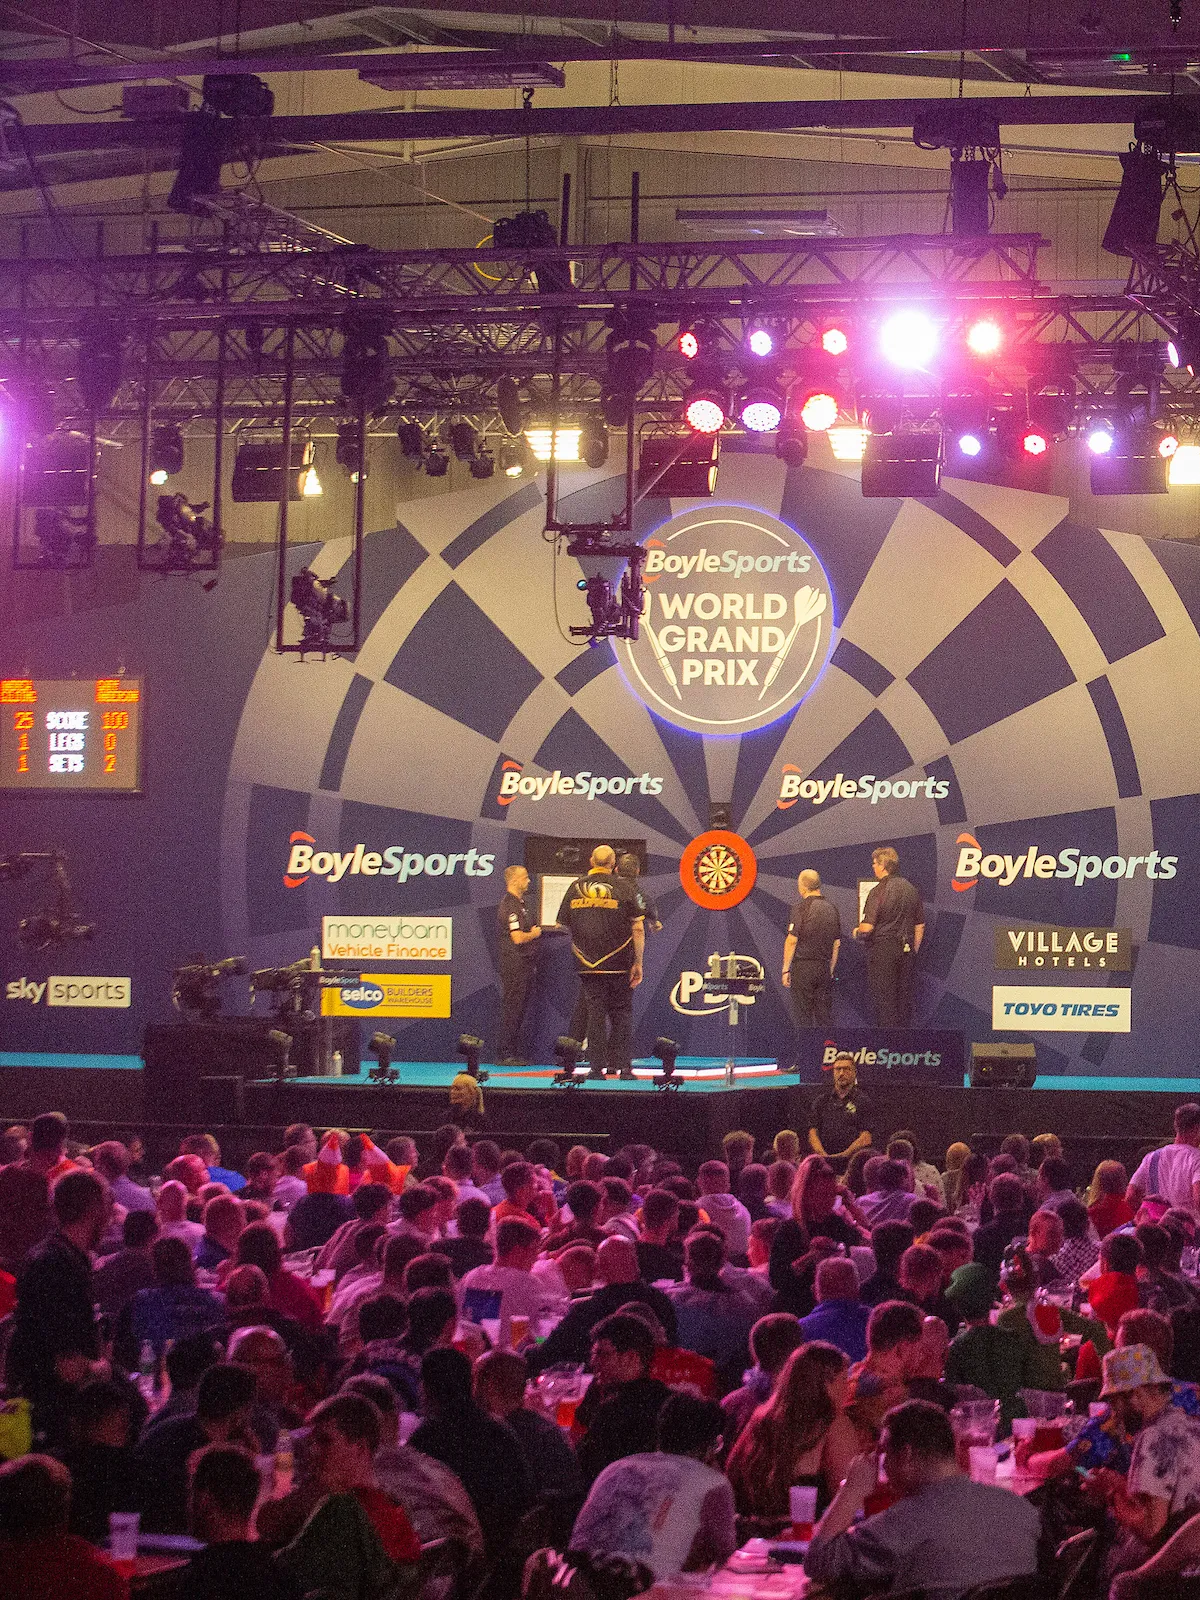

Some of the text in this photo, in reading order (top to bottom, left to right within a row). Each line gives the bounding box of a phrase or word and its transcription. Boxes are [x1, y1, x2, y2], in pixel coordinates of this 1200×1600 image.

[645, 549, 812, 578] BoyleSports
[659, 593, 788, 620] WORLD
[658, 626, 788, 653] GRAND
[682, 659, 759, 686] PRIX
[46, 711, 89, 729] SCORE
[17, 733, 30, 751] 1
[104, 732, 117, 751] 0
[17, 754, 30, 772] 1
[104, 754, 116, 772] 2
[500, 770, 664, 800] BoyleSports
[780, 774, 950, 804] BoyleSports
[287, 844, 495, 883] BoyleSports
[955, 846, 1178, 886] BoyleSports
[327, 918, 448, 942] moneybarn
[1008, 931, 1118, 953] VILLAGE
[328, 943, 447, 958] Vehicle Finance
[1018, 956, 1106, 967] HOTELS
[6, 977, 126, 1004] sky sports
[340, 987, 384, 1002] selco
[387, 988, 433, 996] BUILDERS
[1003, 1003, 1120, 1017] TOYO TIRES
